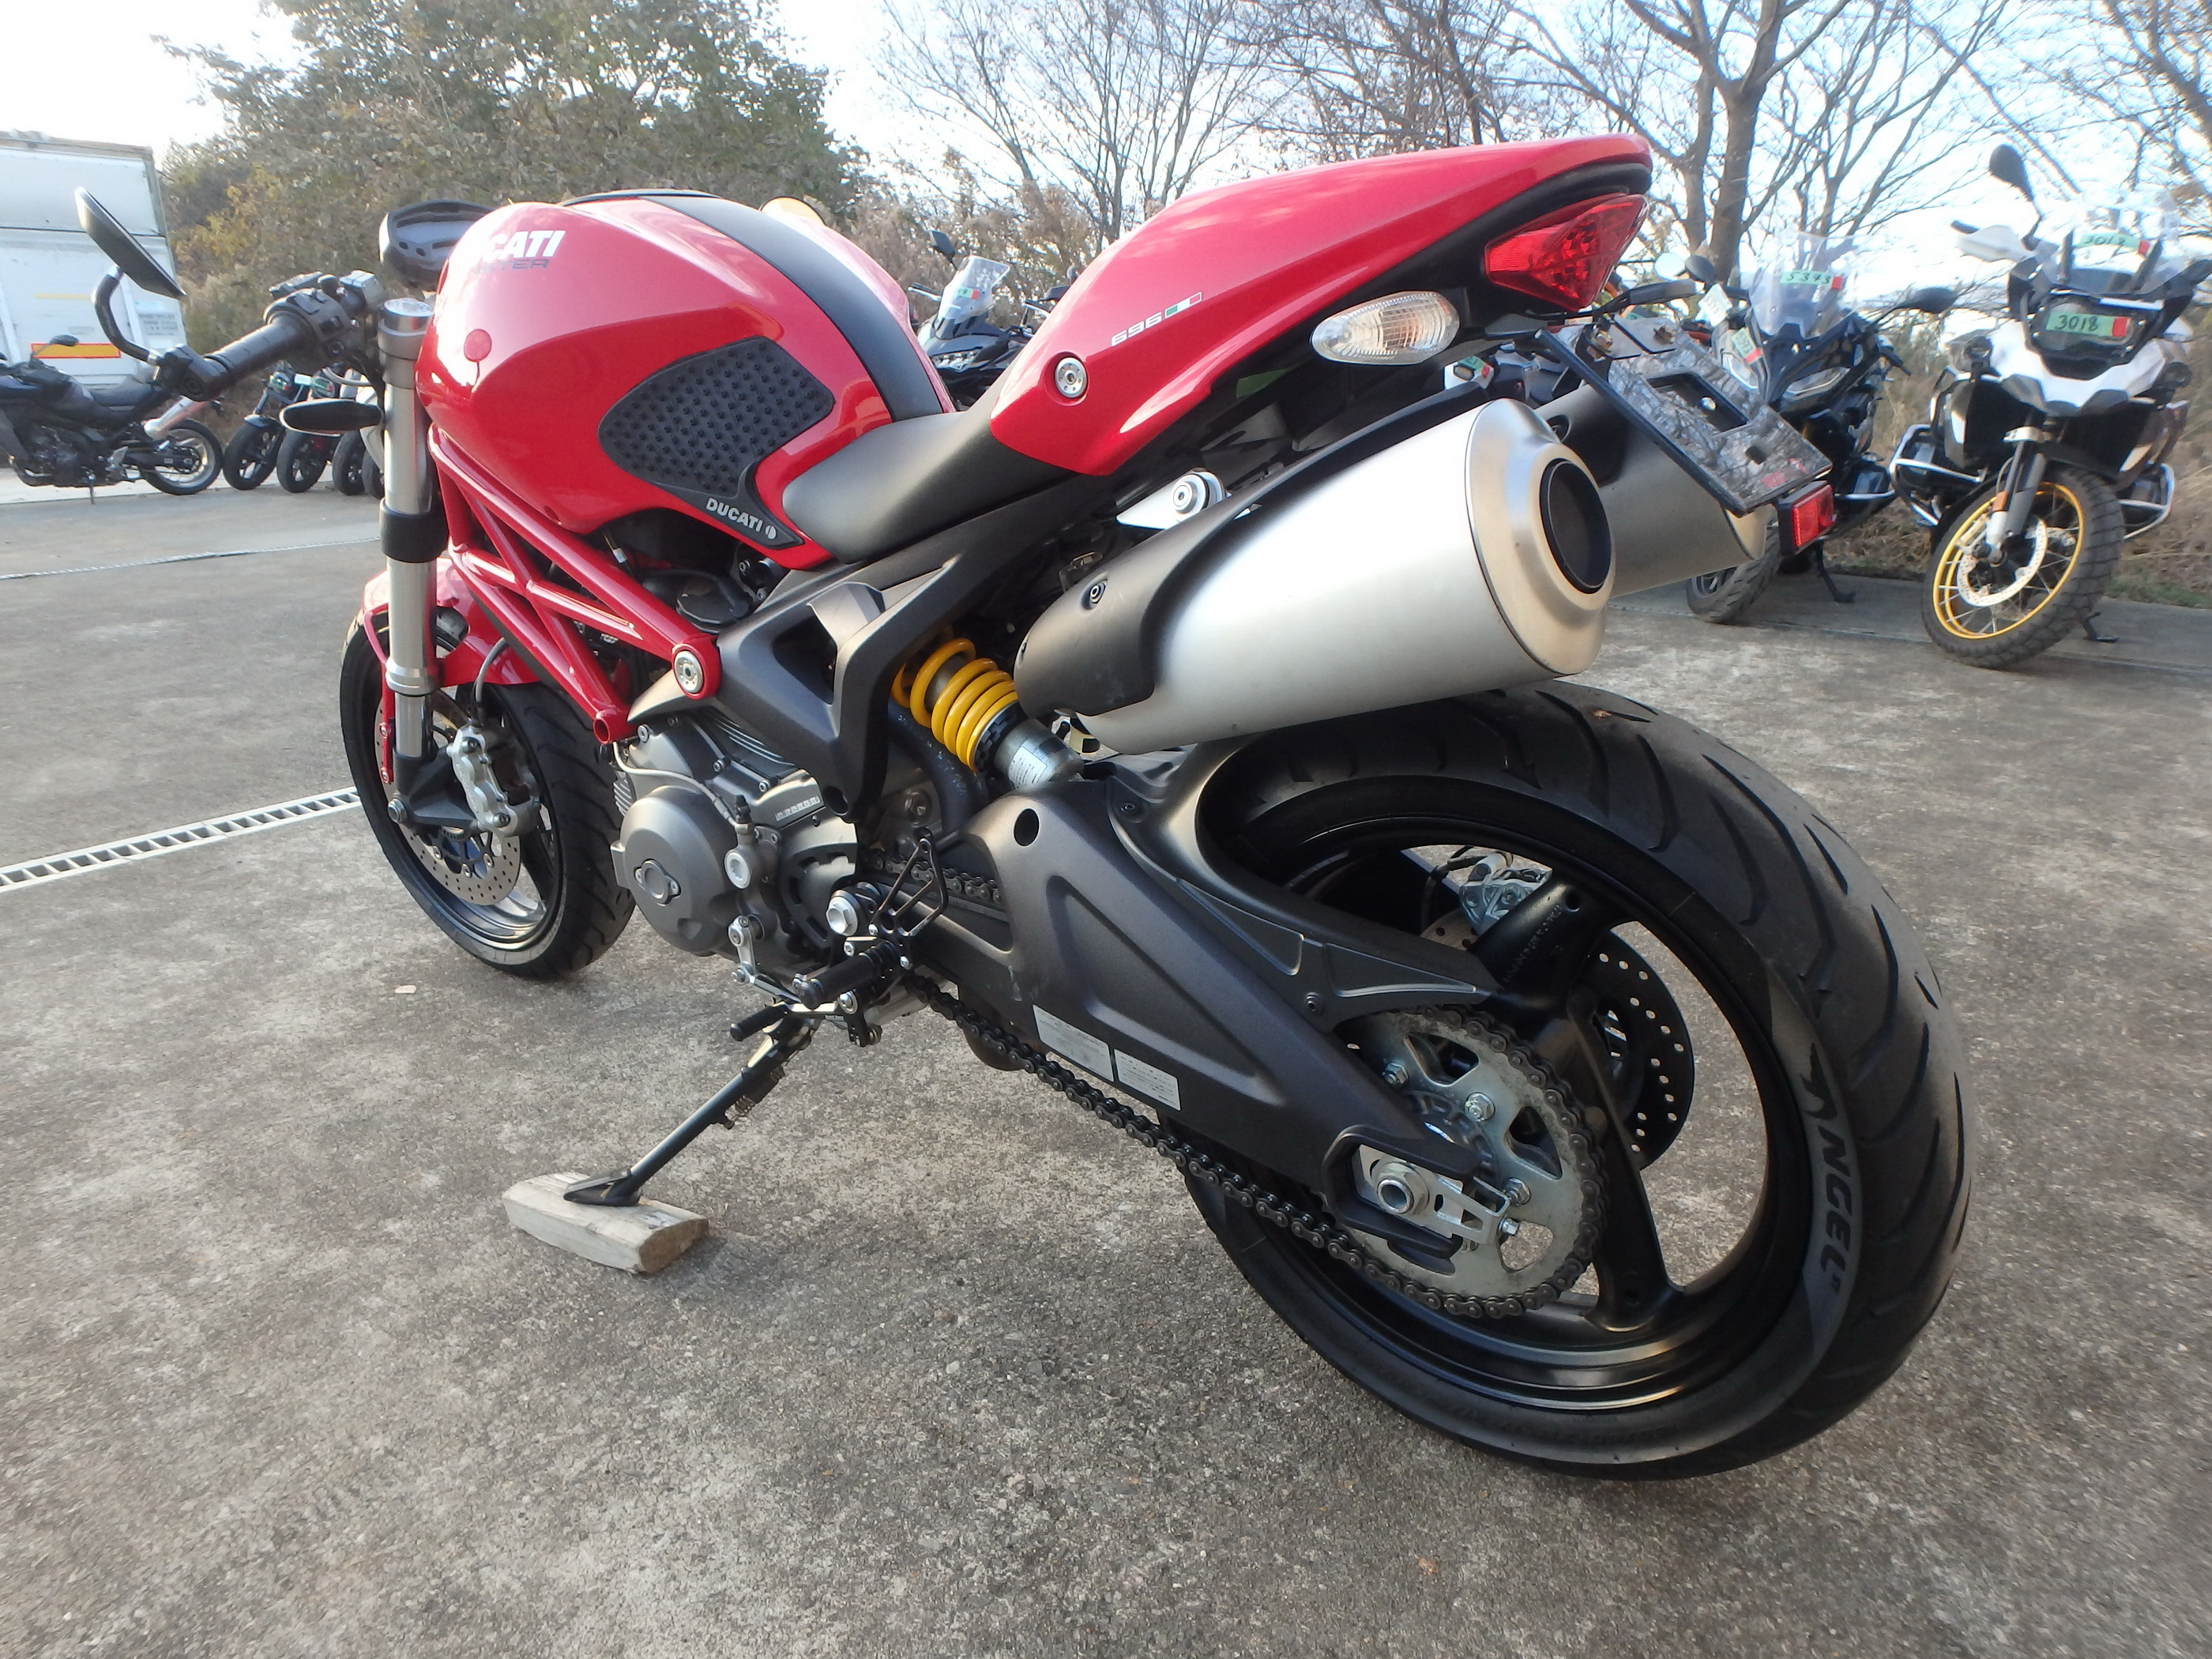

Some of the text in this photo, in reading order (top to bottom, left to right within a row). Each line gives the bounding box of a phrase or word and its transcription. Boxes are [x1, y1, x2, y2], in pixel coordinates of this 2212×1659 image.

[1112, 311, 1162, 347] 696
[2055, 314, 2099, 331] 3018
[705, 497, 764, 532] DUCATI
[1800, 1043, 1853, 1273] ANGEL
